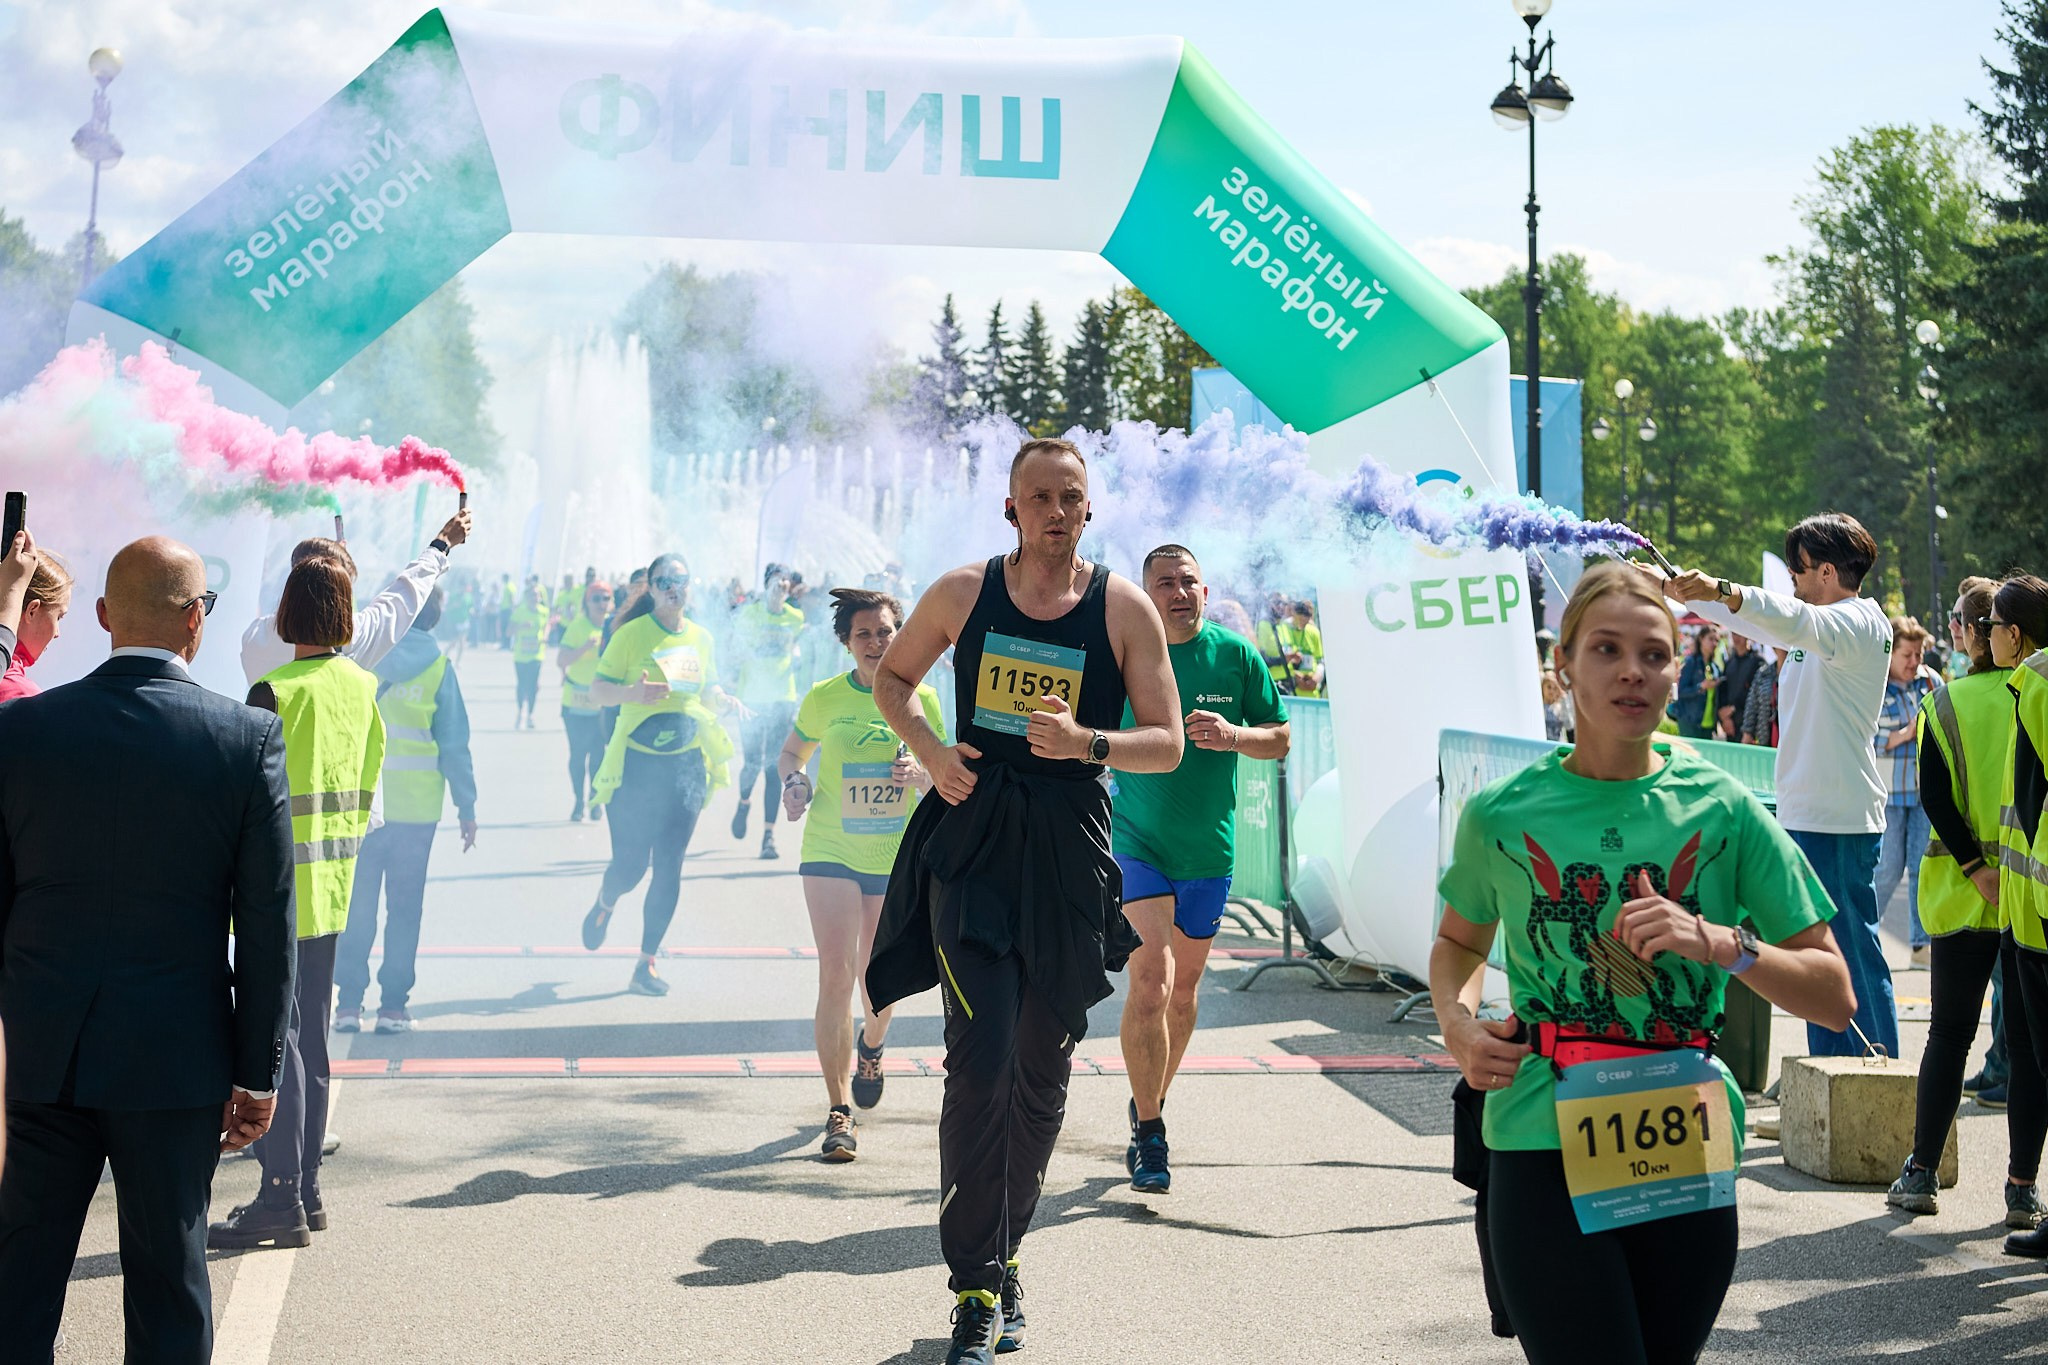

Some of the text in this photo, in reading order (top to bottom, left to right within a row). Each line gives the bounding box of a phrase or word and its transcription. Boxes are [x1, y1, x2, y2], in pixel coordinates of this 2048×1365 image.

[557, 72, 1062, 181] ФИНИШ
[223, 116, 405, 279] зелёный
[249, 159, 433, 312] марафон
[1221, 166, 1389, 321] зелёный
[1193, 194, 1359, 351] марафон
[1364, 573, 1520, 633] СБЕР
[989, 665, 1071, 703] 11593
[1577, 1101, 1711, 1158] 11681
